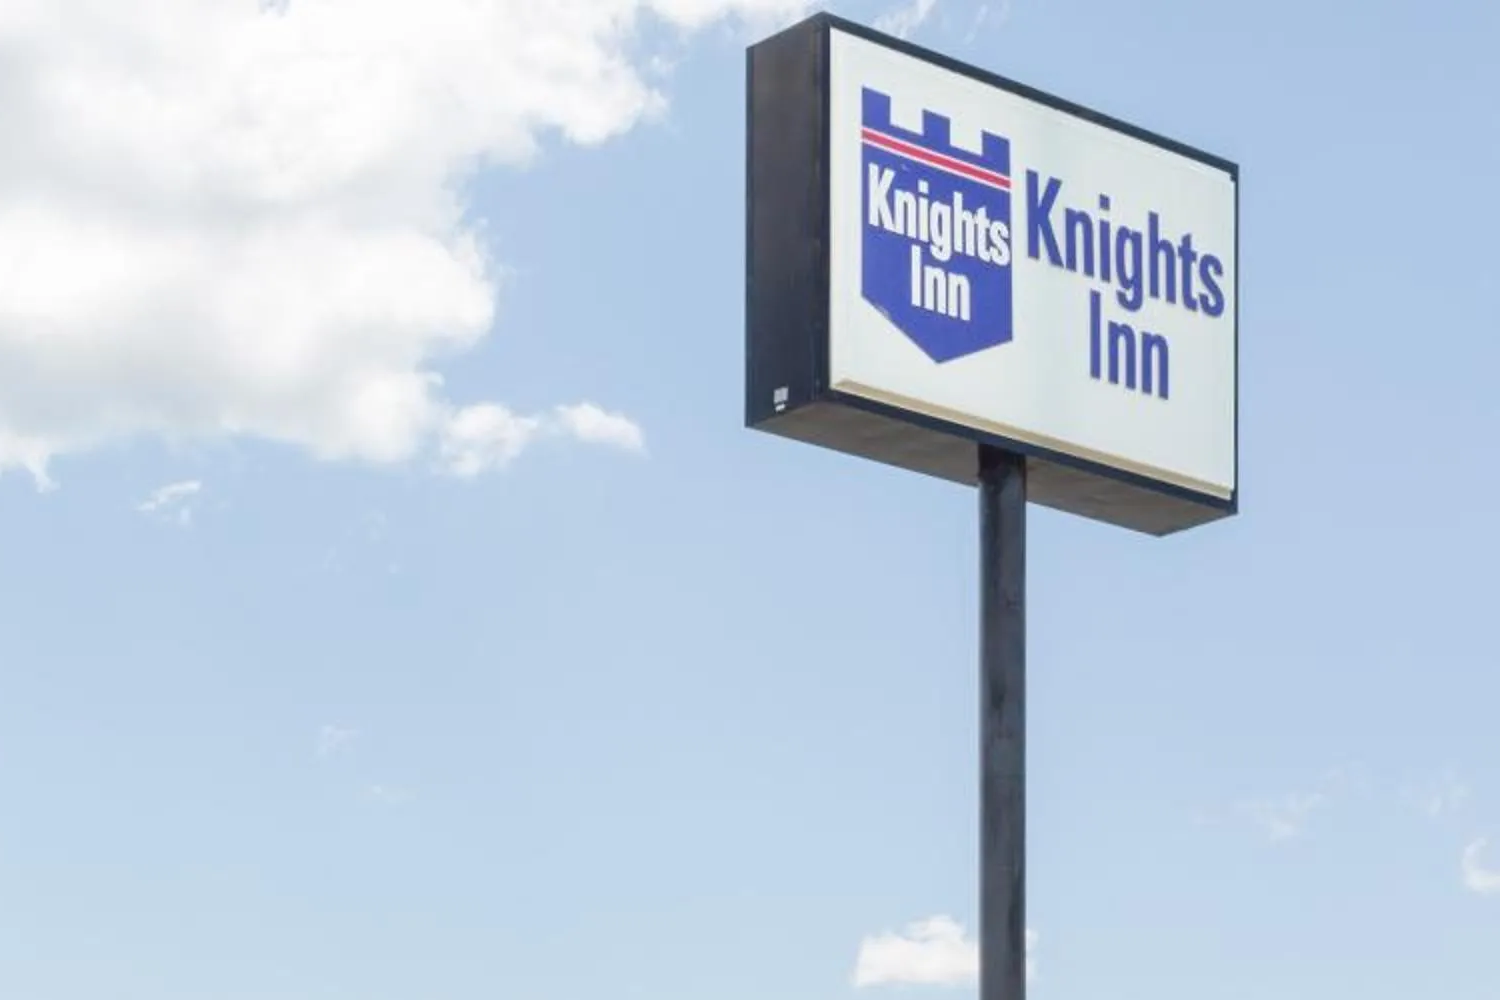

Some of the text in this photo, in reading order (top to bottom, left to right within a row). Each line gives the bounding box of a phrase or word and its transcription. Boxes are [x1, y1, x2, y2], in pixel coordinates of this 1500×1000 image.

[868, 162, 1011, 266] Knights
[1025, 169, 1225, 318] Knights
[911, 245, 971, 321] Inn
[1090, 291, 1169, 400] Inn
